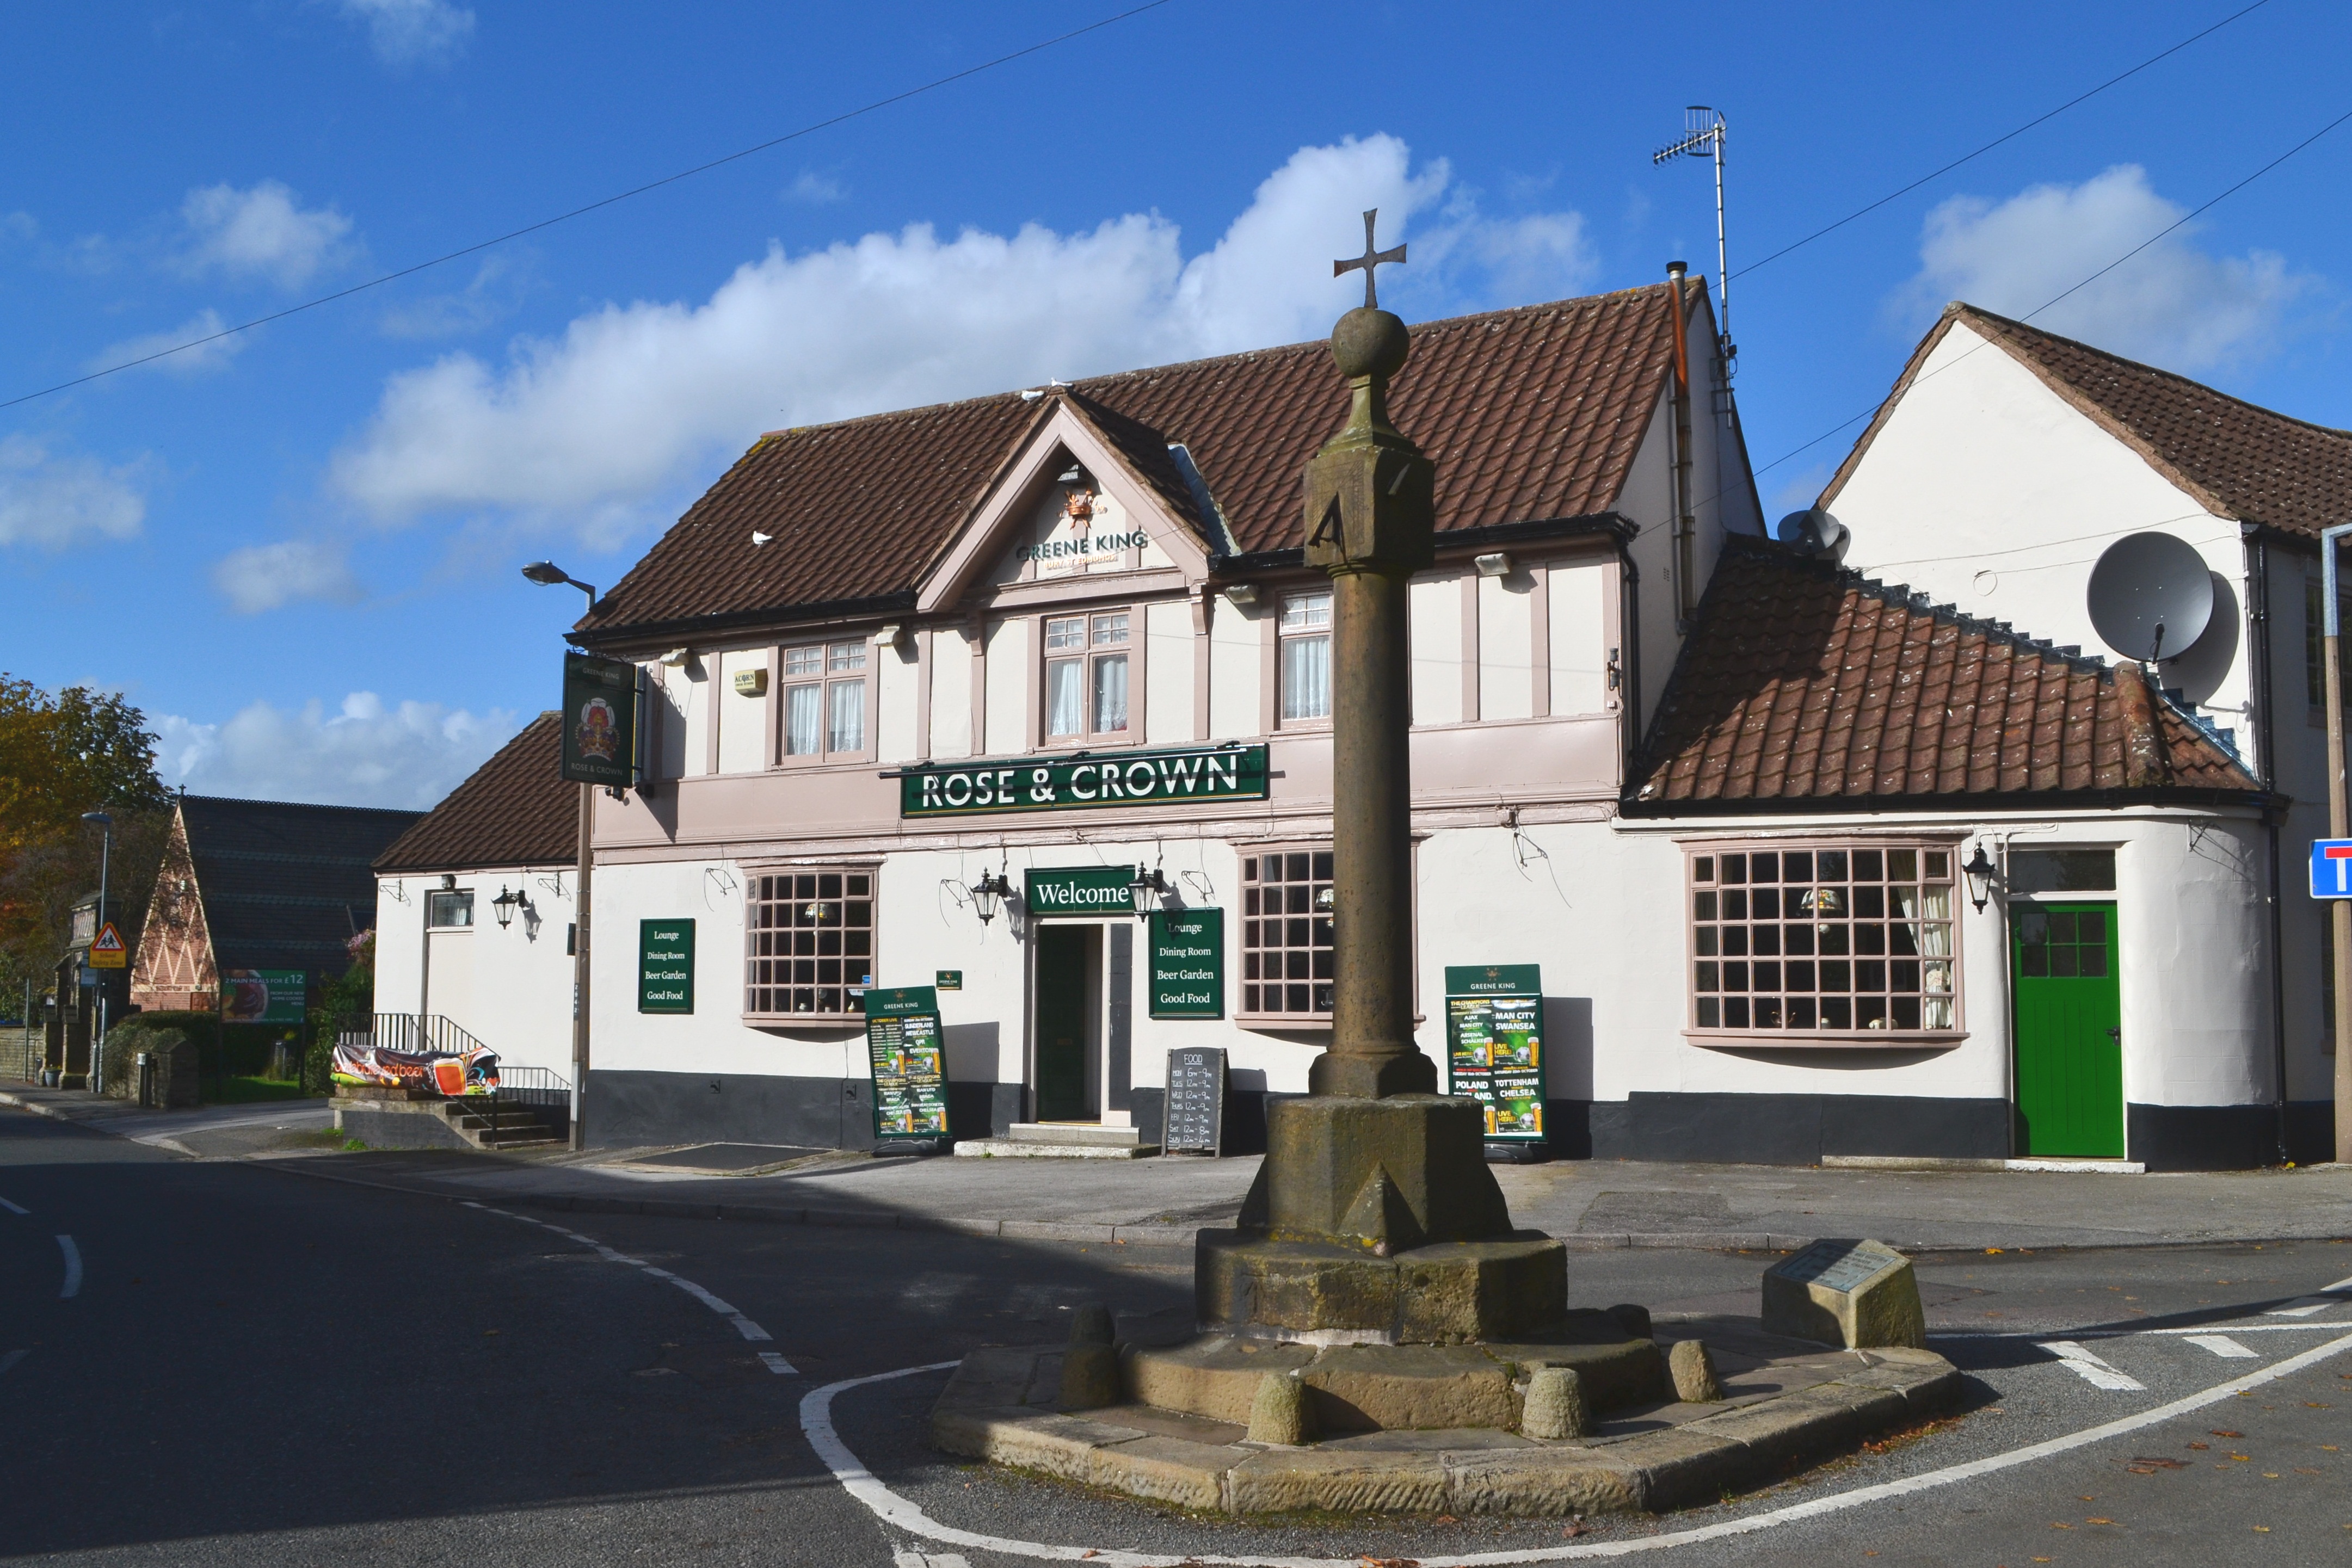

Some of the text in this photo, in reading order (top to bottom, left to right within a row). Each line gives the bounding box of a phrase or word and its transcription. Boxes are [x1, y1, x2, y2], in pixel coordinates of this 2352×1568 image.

[1016, 531, 1146, 561] GREENE KING
[1044, 554, 1116, 568] BURY ST EDMUNDS
[583, 668, 604, 677] GREENE
[571, 763, 588, 771] ROSE
[596, 766, 623, 775] CROWN
[923, 755, 1237, 807] ROSE & CROWN
[1036, 881, 1129, 904] Welcome
[1168, 923, 1202, 934] Lounge
[654, 931, 679, 941] Lounge
[648, 952, 667, 961] Dining
[1159, 947, 1211, 958] Dining Room
[645, 970, 686, 980] Beer Garden
[1157, 968, 1214, 979] Beer Garden
[647, 991, 683, 999] Good Food
[1160, 992, 1210, 1003] Good Food
[1184, 1054, 1203, 1063] FOOD
[400, 1063, 423, 1077] beer
[1494, 1078, 1538, 1087] TOTTENHAM
[1500, 1089, 1536, 1097] CHELSEA
